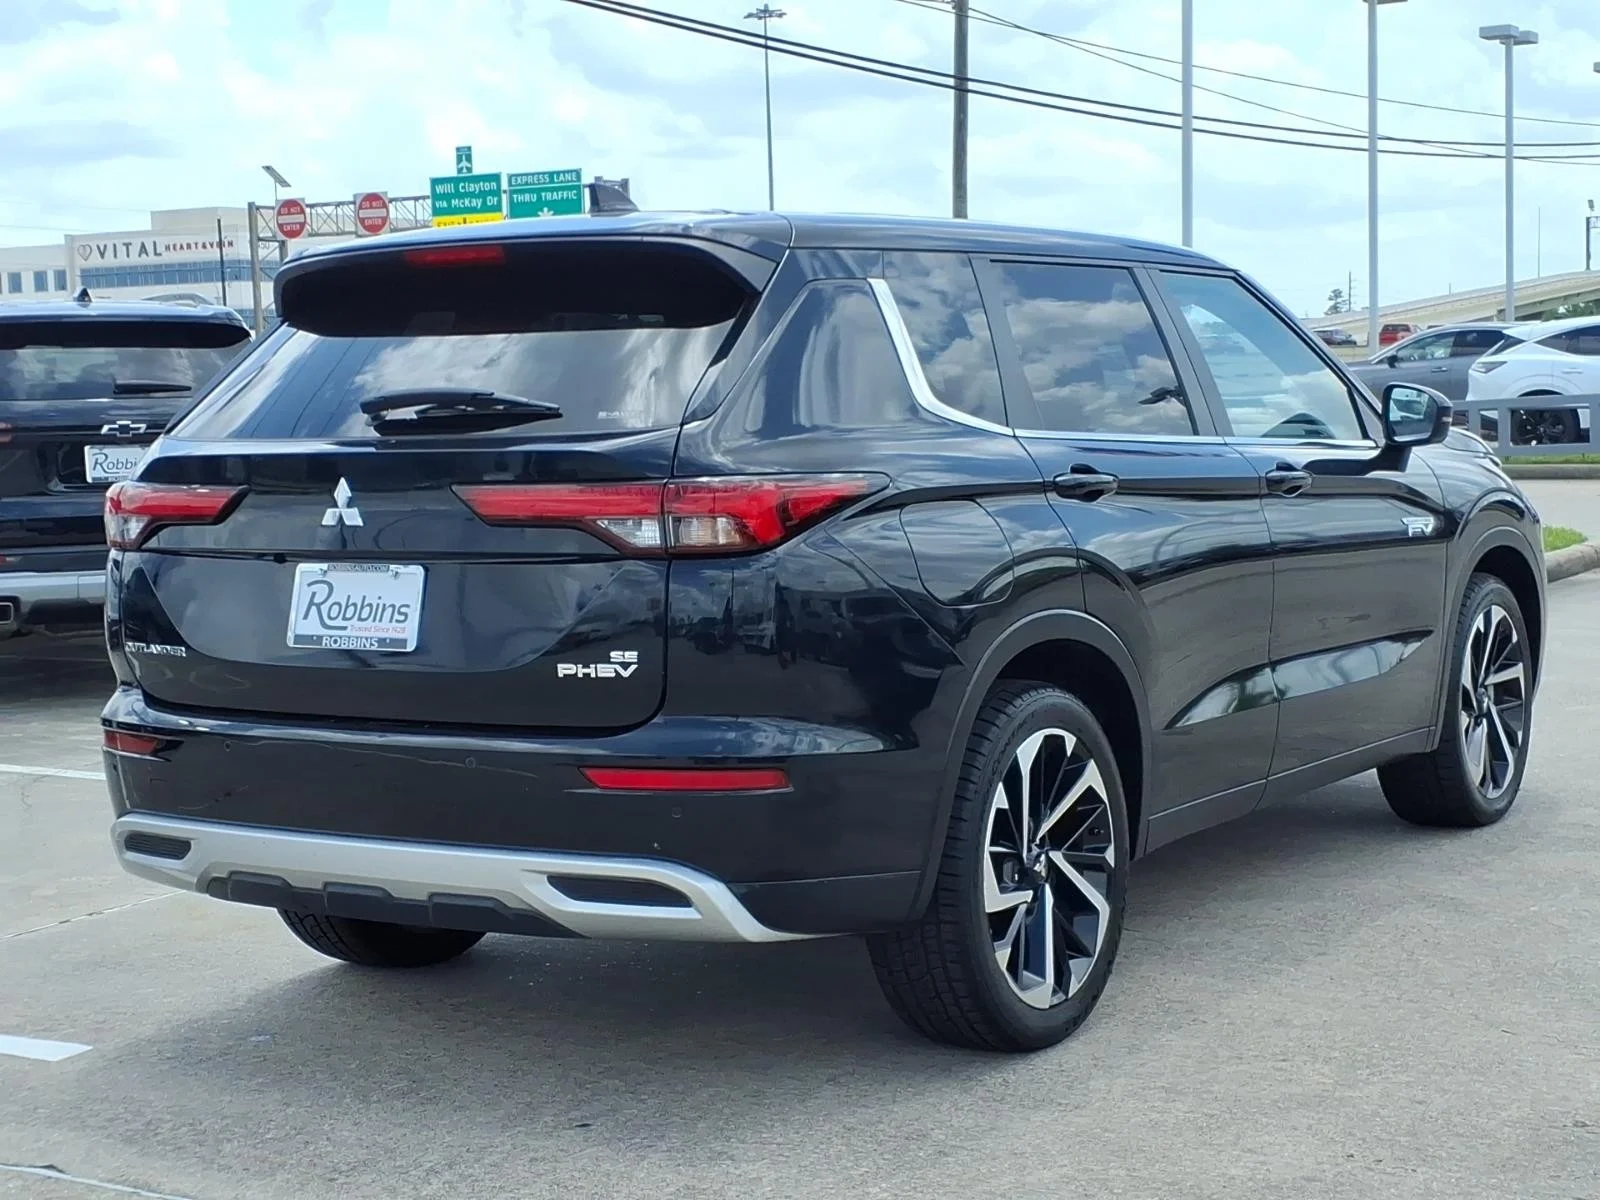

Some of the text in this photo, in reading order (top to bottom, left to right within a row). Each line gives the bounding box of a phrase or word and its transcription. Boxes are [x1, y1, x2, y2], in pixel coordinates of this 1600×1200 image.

[511, 171, 577, 185] EXPRESS LANE
[435, 181, 497, 194] Will Clayton
[435, 196, 498, 210] VIA McKay Dr
[512, 190, 577, 203] THRU TRAFFIC
[280, 206, 301, 215] DO NOT
[361, 200, 383, 209] DO NOT
[283, 224, 300, 232] ENTER
[364, 218, 382, 227] ENTER
[96, 240, 162, 260] VITAL
[302, 579, 411, 631] Robbins
[322, 636, 378, 649] ROBBINS
[609, 650, 639, 663] SE
[556, 663, 639, 678] PHEV
